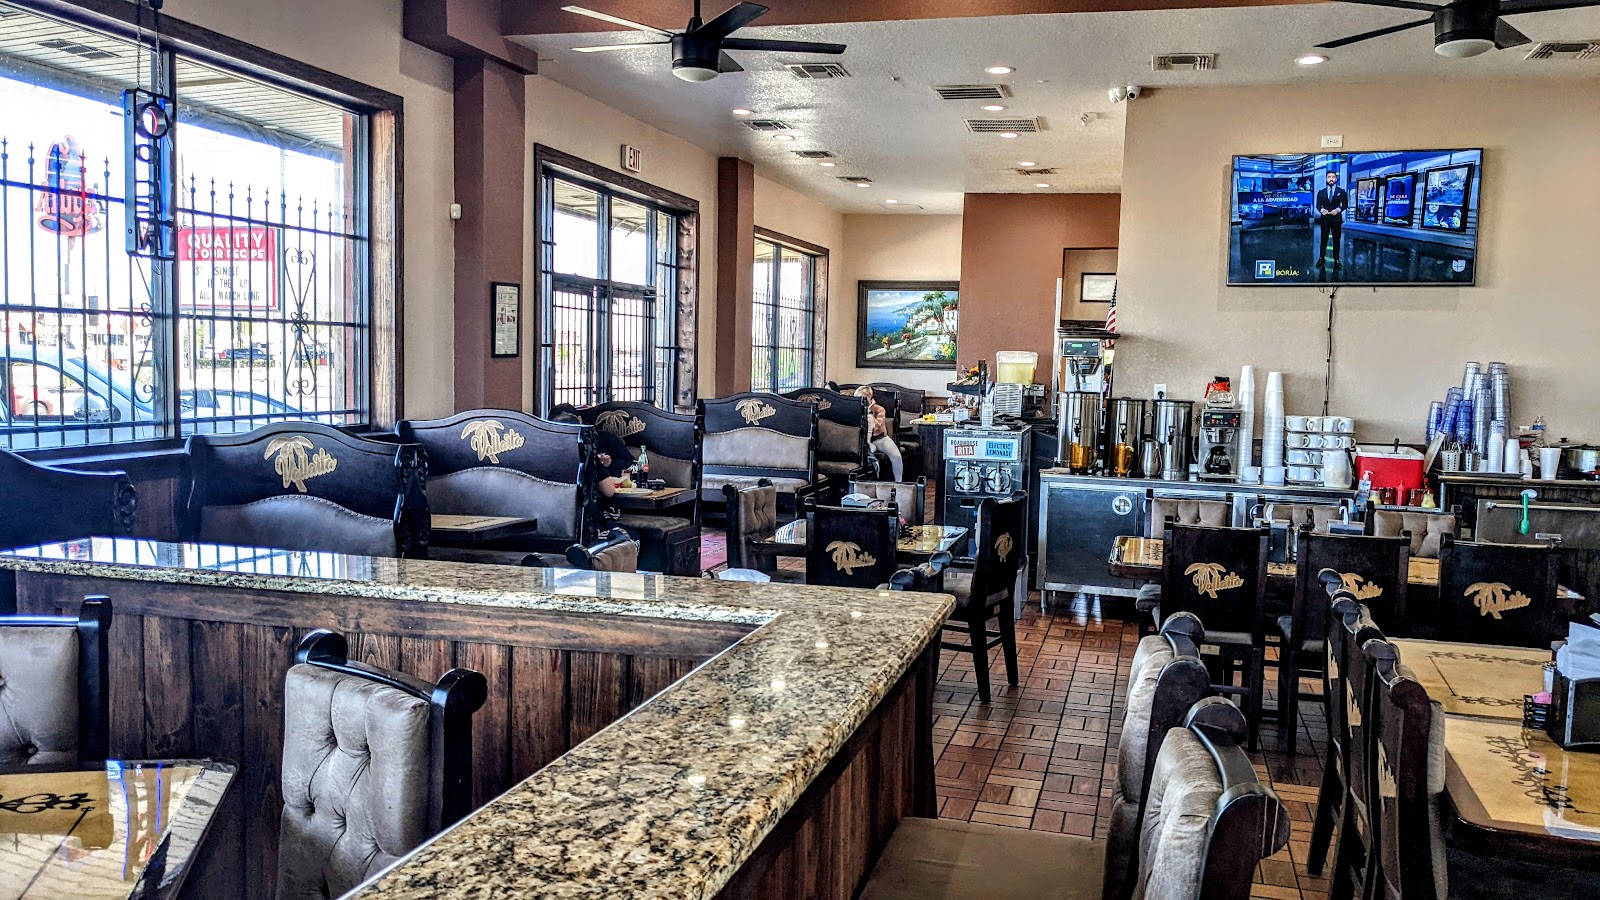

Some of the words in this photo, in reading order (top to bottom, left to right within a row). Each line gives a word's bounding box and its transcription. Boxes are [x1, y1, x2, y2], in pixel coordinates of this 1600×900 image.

[629, 147, 640, 170] EXIT
[187, 232, 264, 249] QUALITY
[188, 248, 199, 259] IS
[200, 248, 223, 259] OUR
[226, 248, 265, 259] ECPE
[218, 291, 241, 301] MACH
[243, 291, 260, 301] LNG
[950, 439, 979, 447] ROADHOUSE
[988, 442, 1011, 450] ELECTRIC
[986, 449, 1012, 457] LEMONADE
